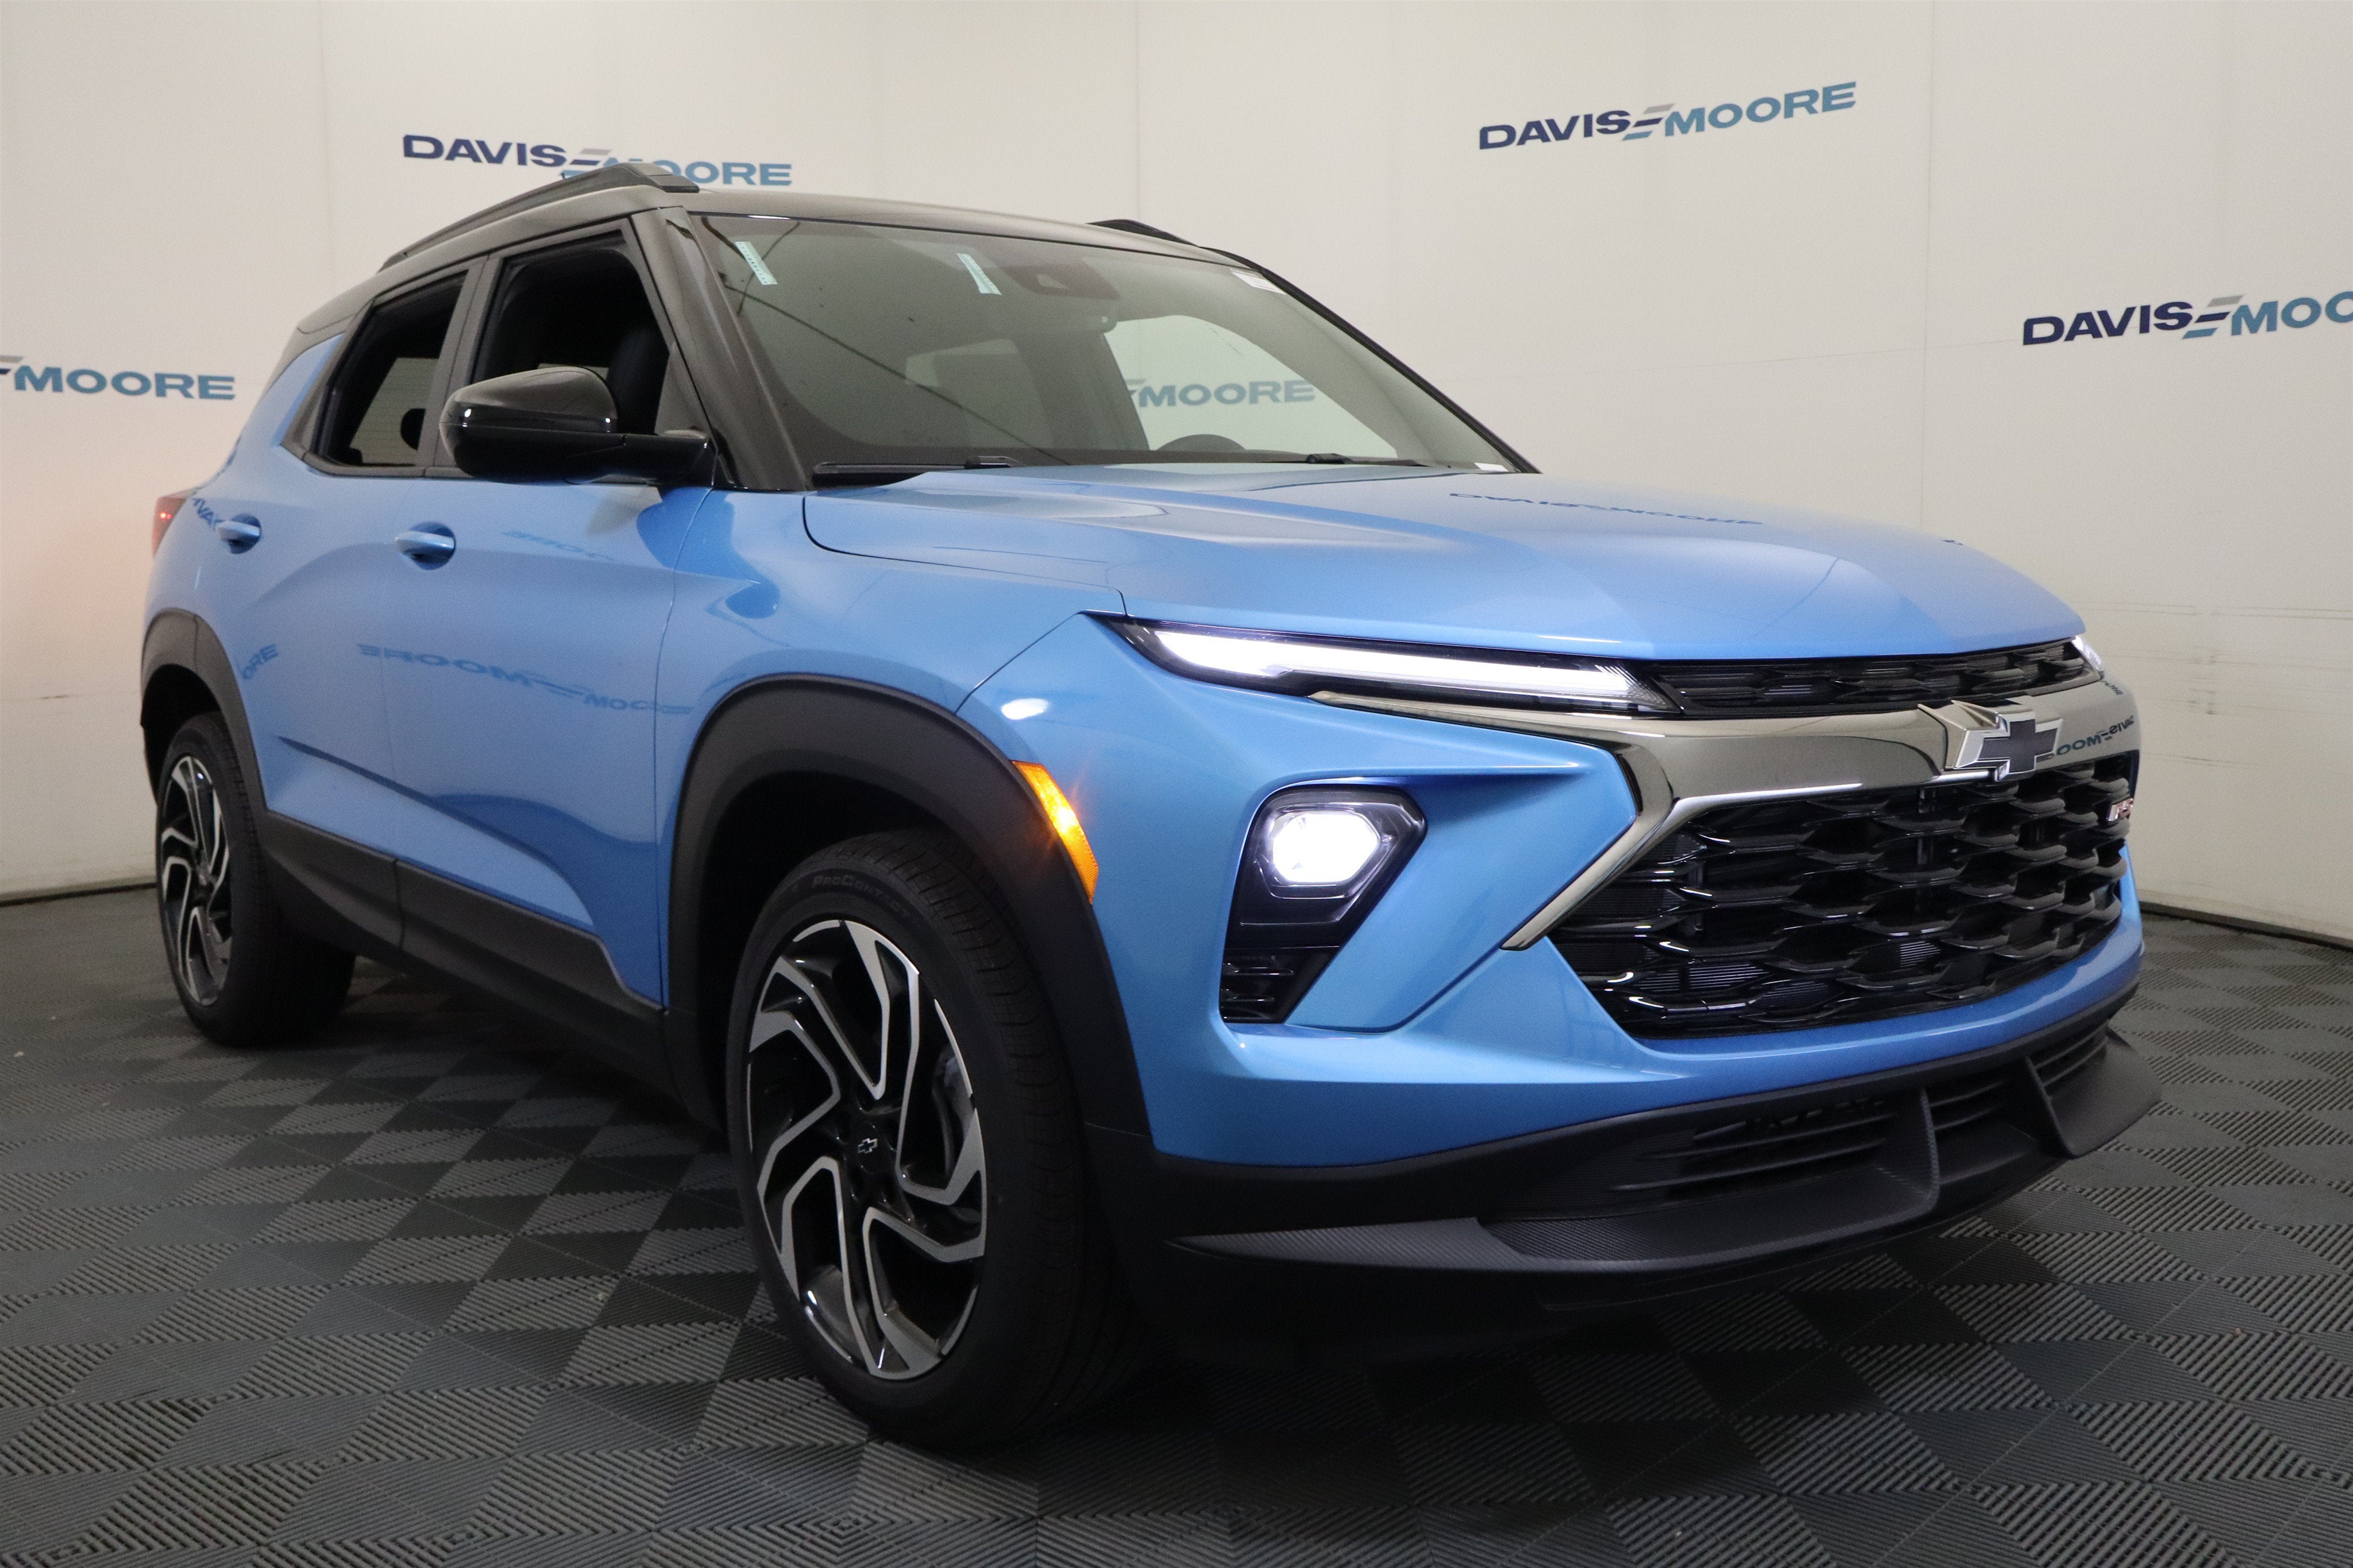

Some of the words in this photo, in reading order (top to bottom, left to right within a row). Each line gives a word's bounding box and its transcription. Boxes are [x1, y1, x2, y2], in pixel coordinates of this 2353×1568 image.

[1479, 110, 1631, 150] DAVIS
[1665, 81, 1857, 137] MOORE
[403, 134, 566, 167] DAVIS
[604, 157, 792, 186] ORE
[2023, 301, 2193, 346] DAVIS
[14, 365, 236, 400] MOORE
[1139, 379, 1316, 407] MOORE
